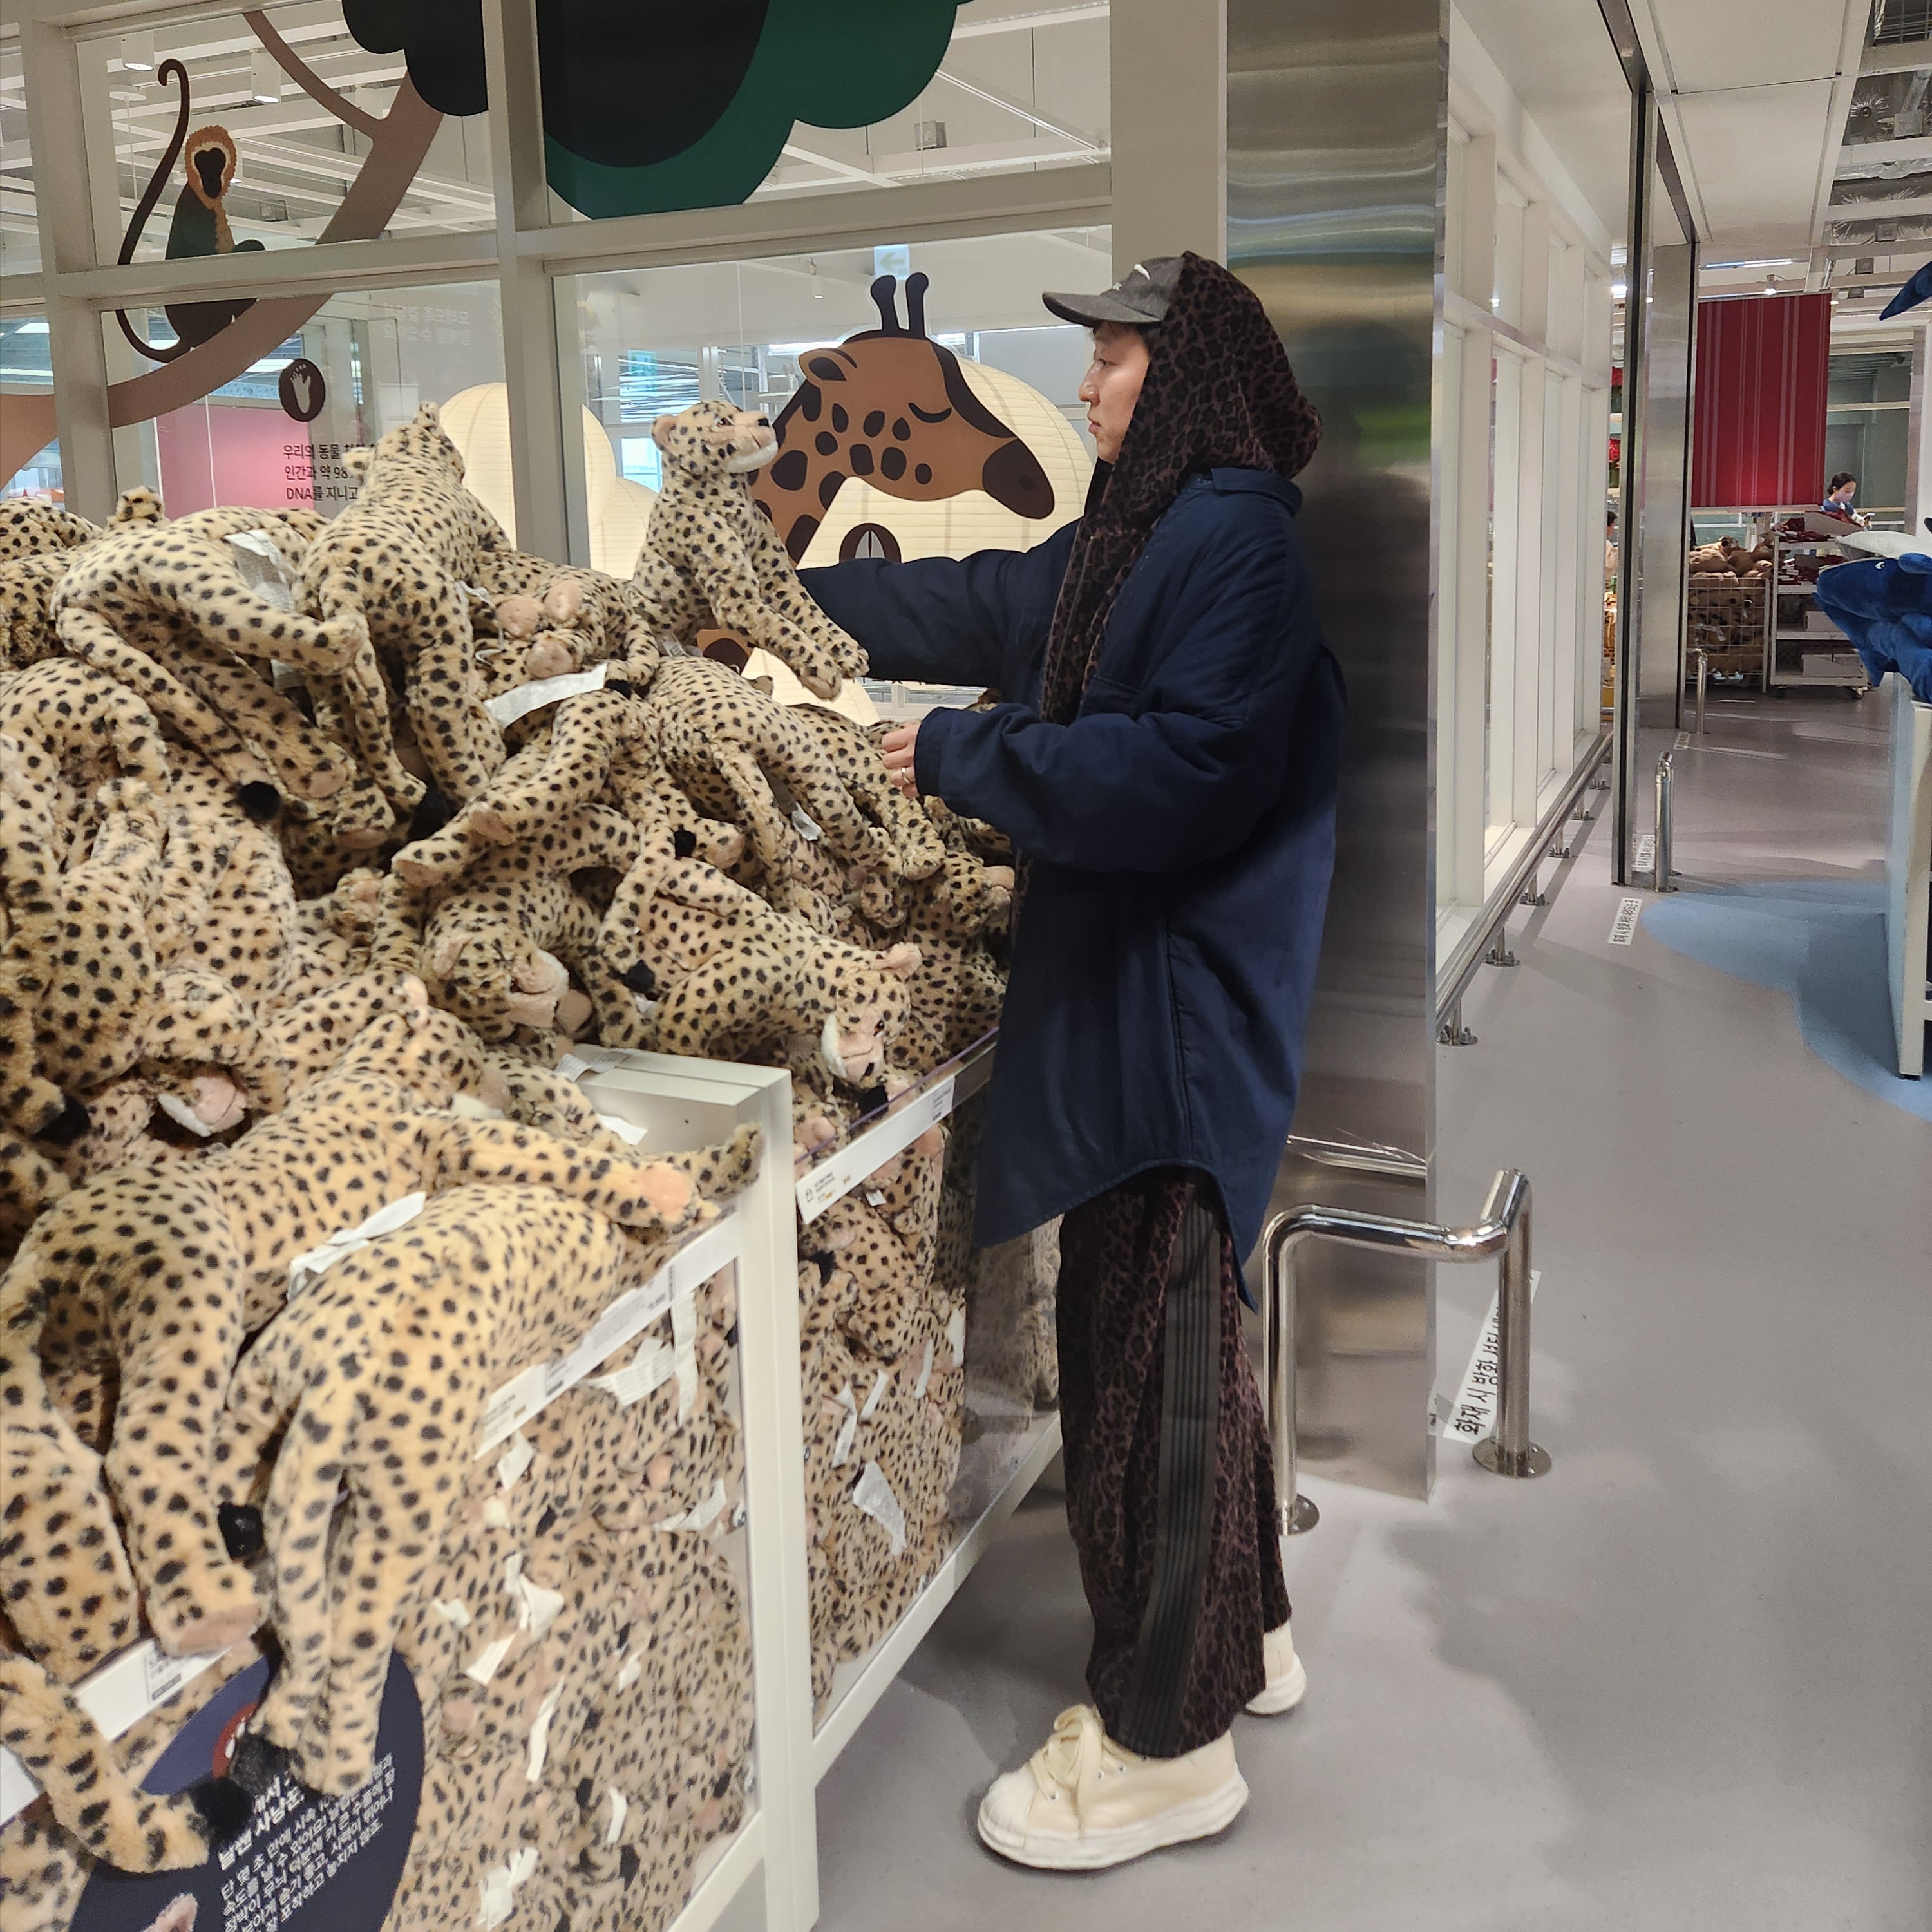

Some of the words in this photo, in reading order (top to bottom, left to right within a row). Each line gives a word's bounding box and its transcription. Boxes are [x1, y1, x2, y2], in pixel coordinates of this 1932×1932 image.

[283, 444, 316, 459] 우리의
[318, 444, 341, 460] 동물
[285, 465, 316, 480] 인간과
[319, 464, 331, 480] 약
[286, 486, 323, 502] DNA를
[326, 486, 358, 501] 지니고
[1472, 1359, 1498, 1385] 방화
[1467, 1387, 1495, 1403] 시
[1454, 1404, 1490, 1435] 화재
[325, 1823, 336, 1841] 키
[338, 1811, 349, 1830] 큰
[221, 1879, 234, 1900] 단
[252, 1853, 265, 1872] 초
[267, 1827, 291, 1859] 만에
[294, 1808, 316, 1833] 시속
[276, 1853, 288, 1867] 수
